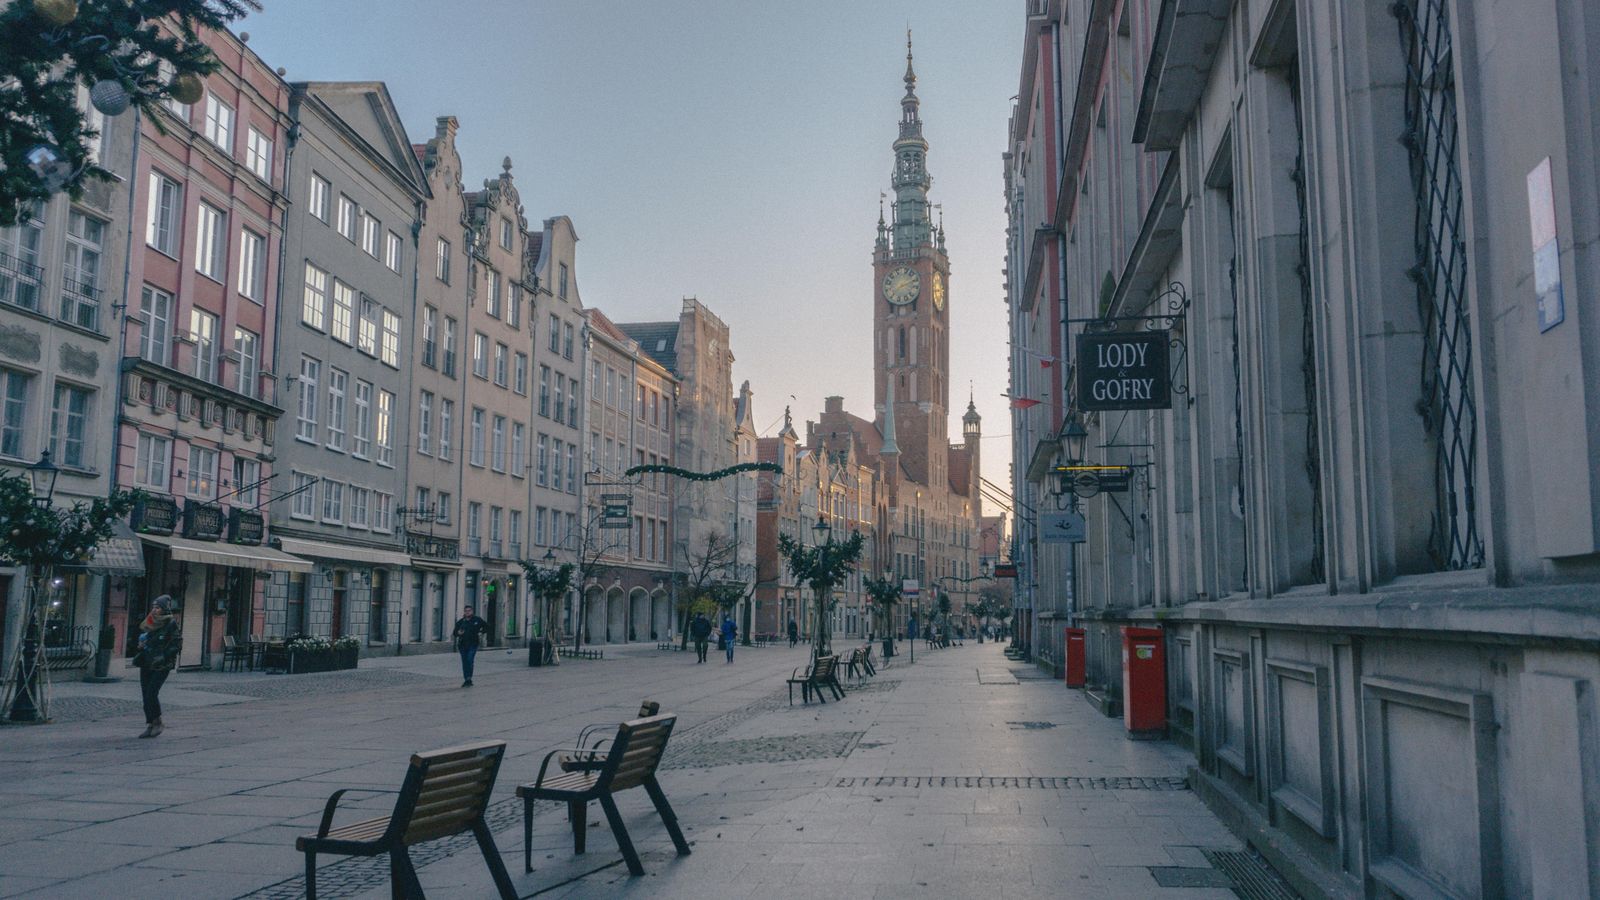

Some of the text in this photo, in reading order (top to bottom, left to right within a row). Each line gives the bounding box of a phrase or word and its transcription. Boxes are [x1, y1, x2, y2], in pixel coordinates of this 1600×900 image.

[1098, 343, 1149, 368] LODY
[1118, 369, 1127, 377] &
[1092, 378, 1154, 400] GOFRY
[196, 514, 218, 528] NAPOLI
